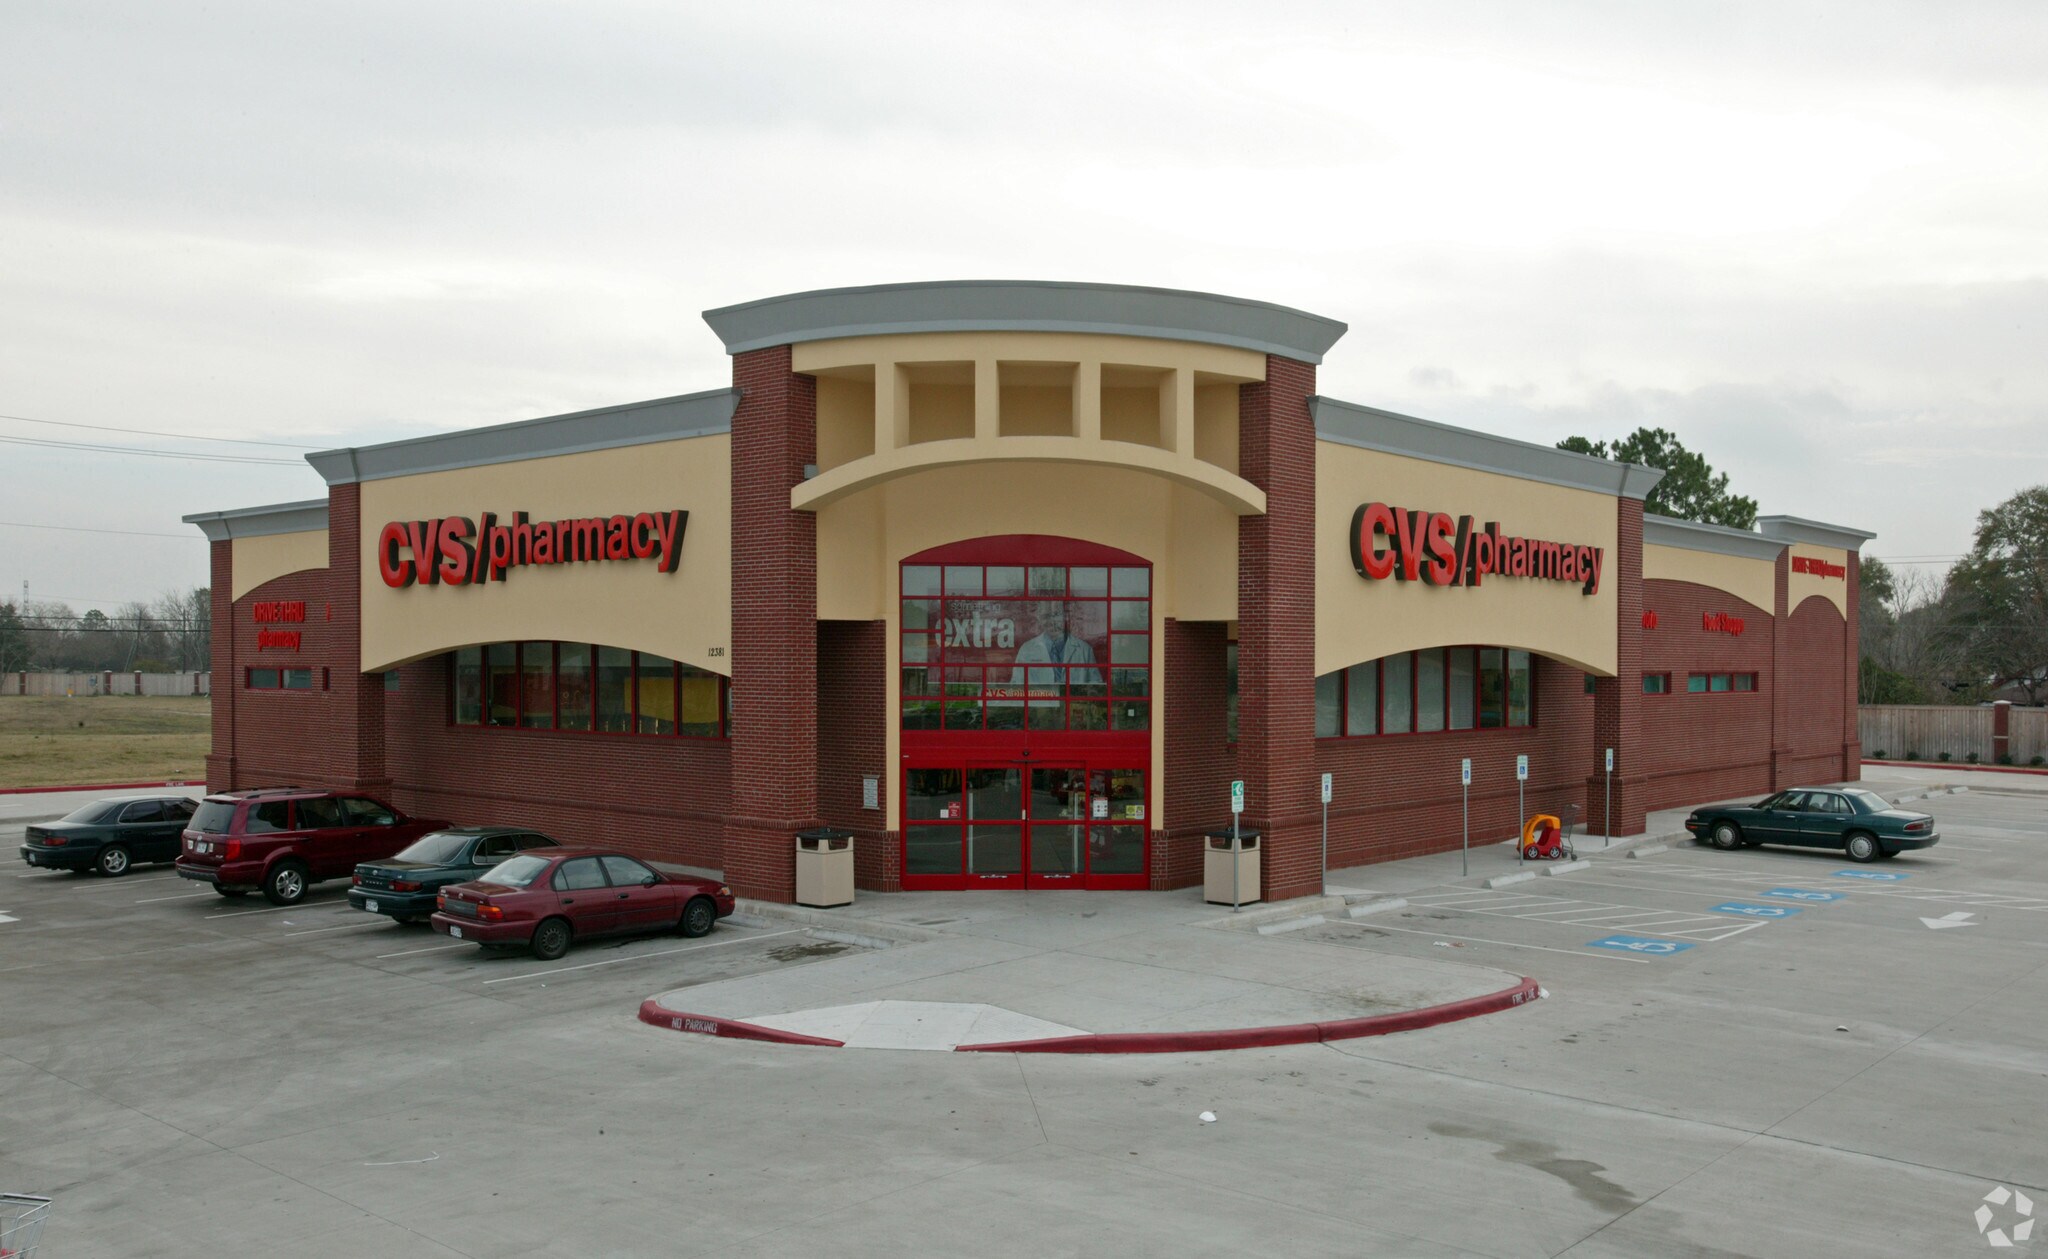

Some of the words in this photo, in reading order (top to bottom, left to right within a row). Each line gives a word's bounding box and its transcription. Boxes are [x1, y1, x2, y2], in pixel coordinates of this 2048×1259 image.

[379, 509, 690, 588] CVS/pharmacy
[1350, 501, 1604, 595] CVS/pharmacy
[257, 625, 302, 652] pharmacy
[935, 611, 1015, 648] extra
[707, 647, 725, 657] 12381
[671, 1017, 682, 1029] NO
[685, 1018, 717, 1033] PARKING
